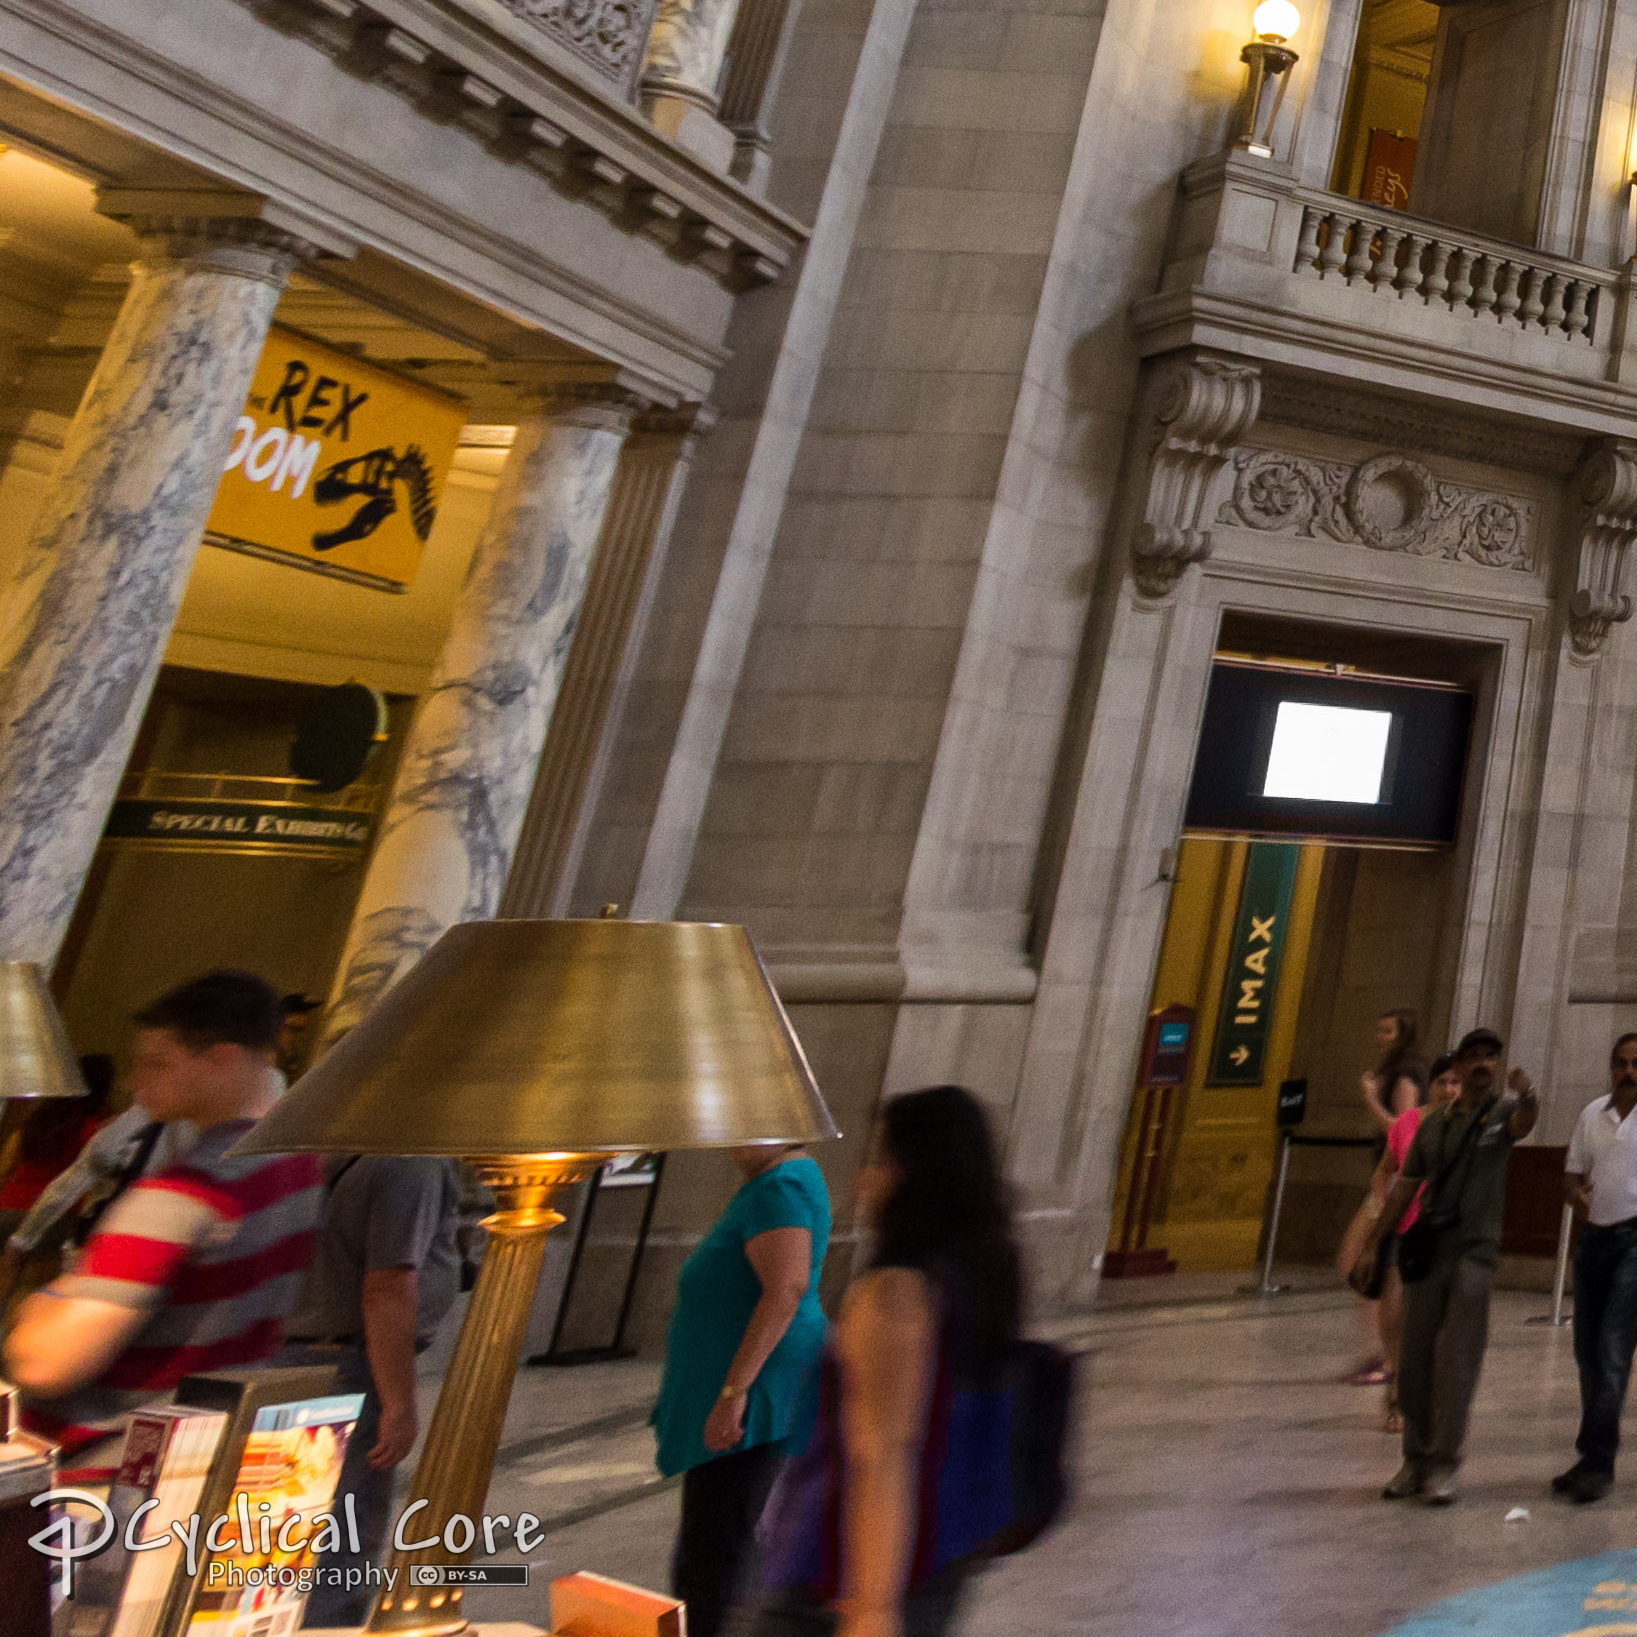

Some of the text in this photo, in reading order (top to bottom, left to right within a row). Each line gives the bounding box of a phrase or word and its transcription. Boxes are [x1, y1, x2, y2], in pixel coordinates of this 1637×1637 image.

[269, 360, 370, 442] REX
[149, 811, 250, 834] SPECIAL
[1234, 915, 1276, 1024] IMAX
